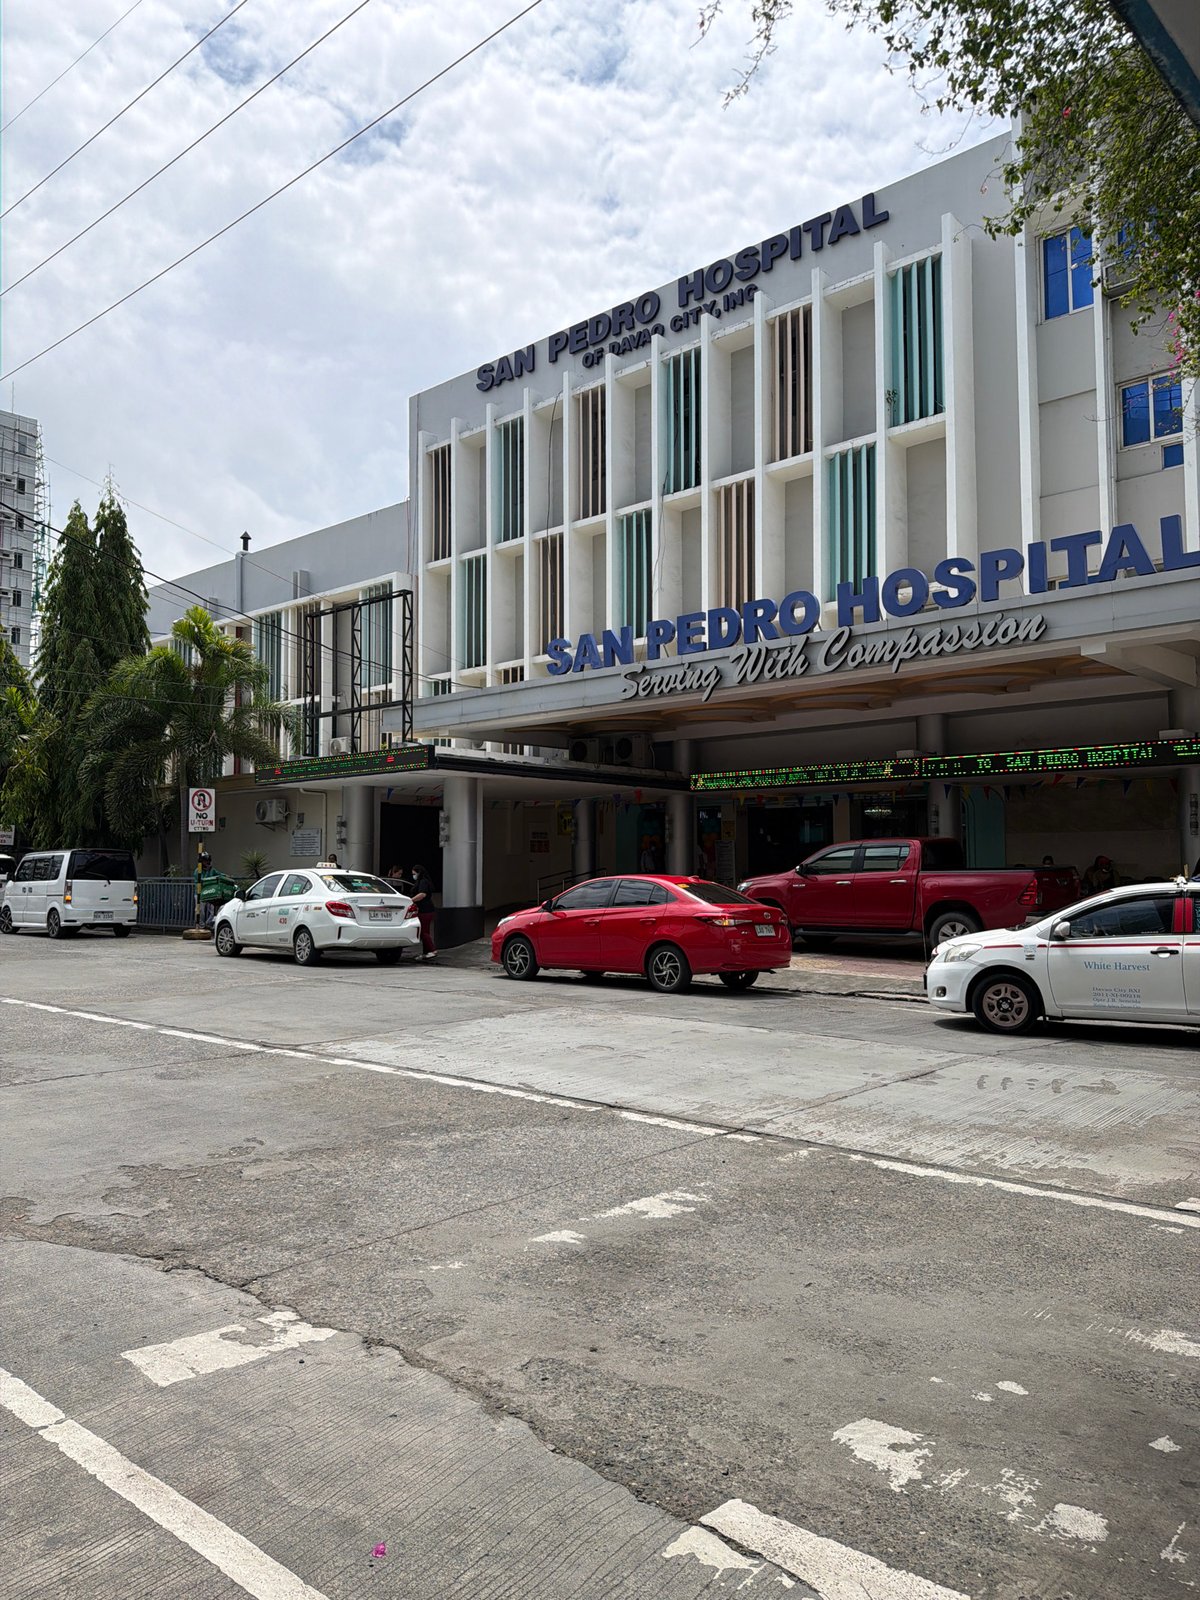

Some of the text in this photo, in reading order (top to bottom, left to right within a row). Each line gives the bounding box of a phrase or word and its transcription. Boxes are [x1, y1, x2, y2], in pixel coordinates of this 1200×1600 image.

[476, 192, 890, 392] SAN PEDRO HOSPITAL
[582, 346, 604, 368] OF
[608, 323, 665, 356] DAVAO
[545, 514, 1200, 677] SAN PEDRO HOSPITAL
[620, 611, 1048, 702] Serving With Compassion
[1083, 961, 1150, 971] White Harvest
